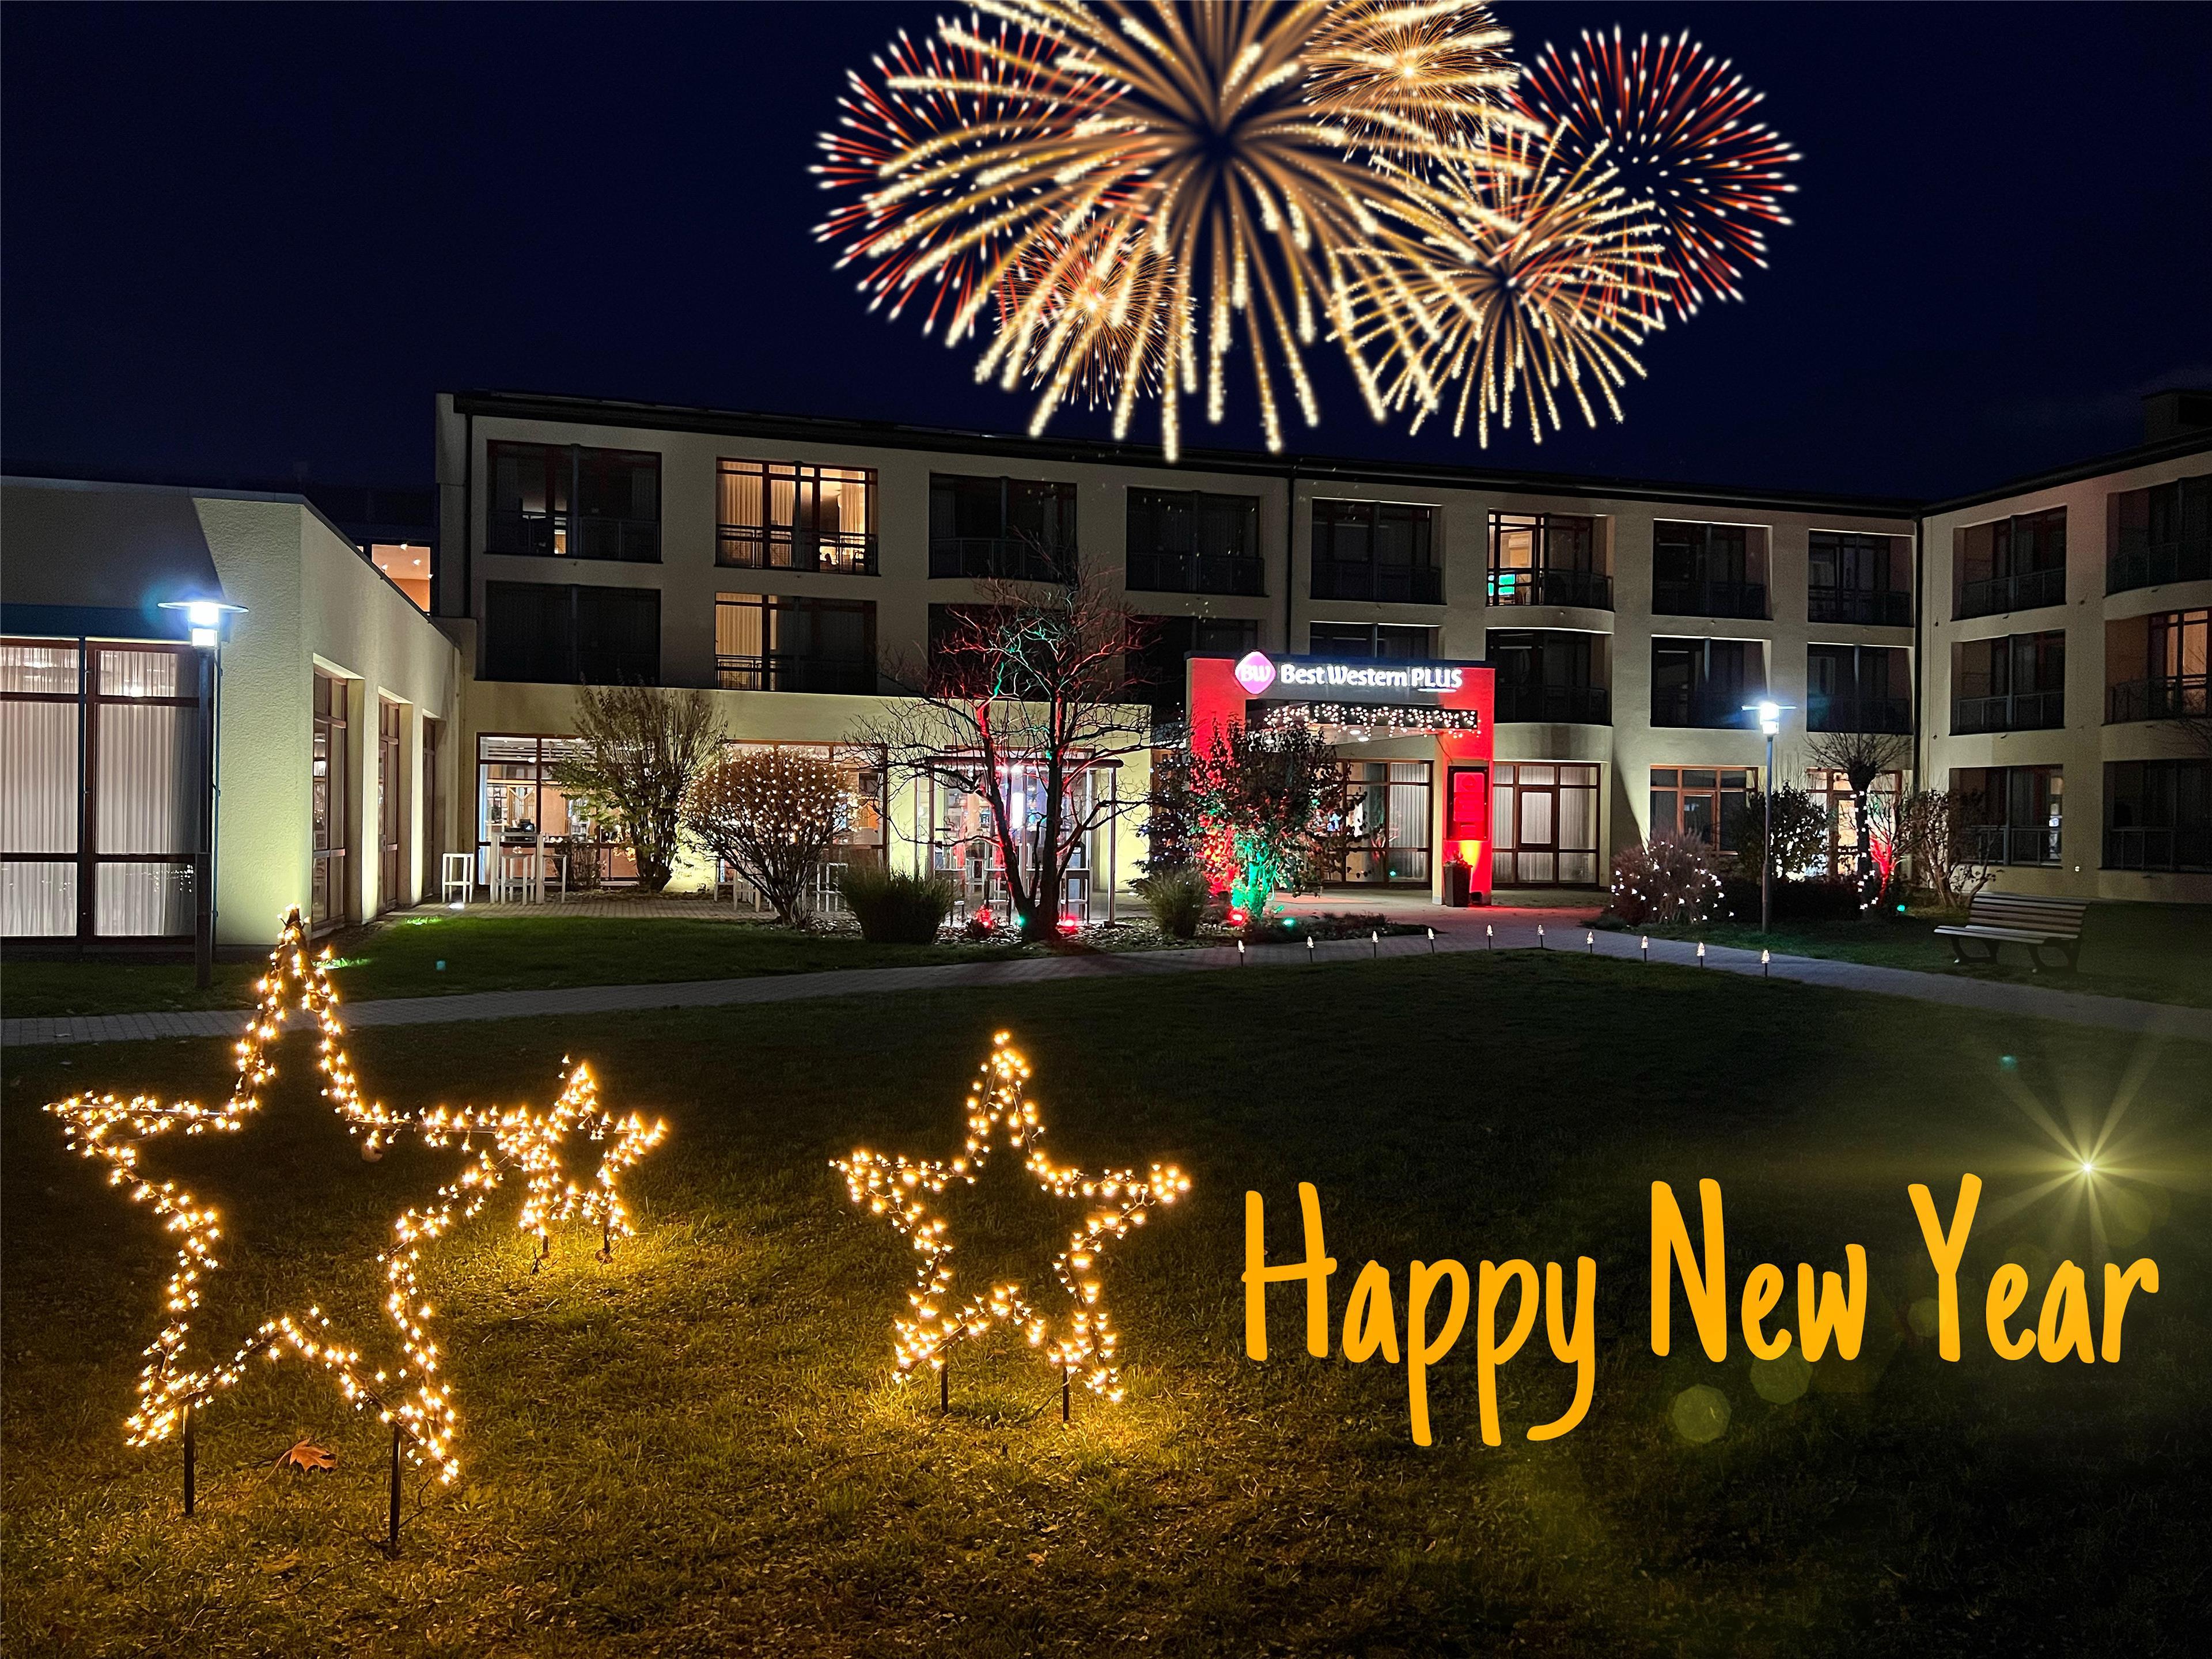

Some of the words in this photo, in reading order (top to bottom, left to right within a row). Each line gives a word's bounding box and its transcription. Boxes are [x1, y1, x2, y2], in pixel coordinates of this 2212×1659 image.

[1240, 665, 1271, 682] BW
[1281, 664, 1324, 684] Best
[1327, 665, 1408, 687] Western
[1411, 668, 1463, 688] PLUS
